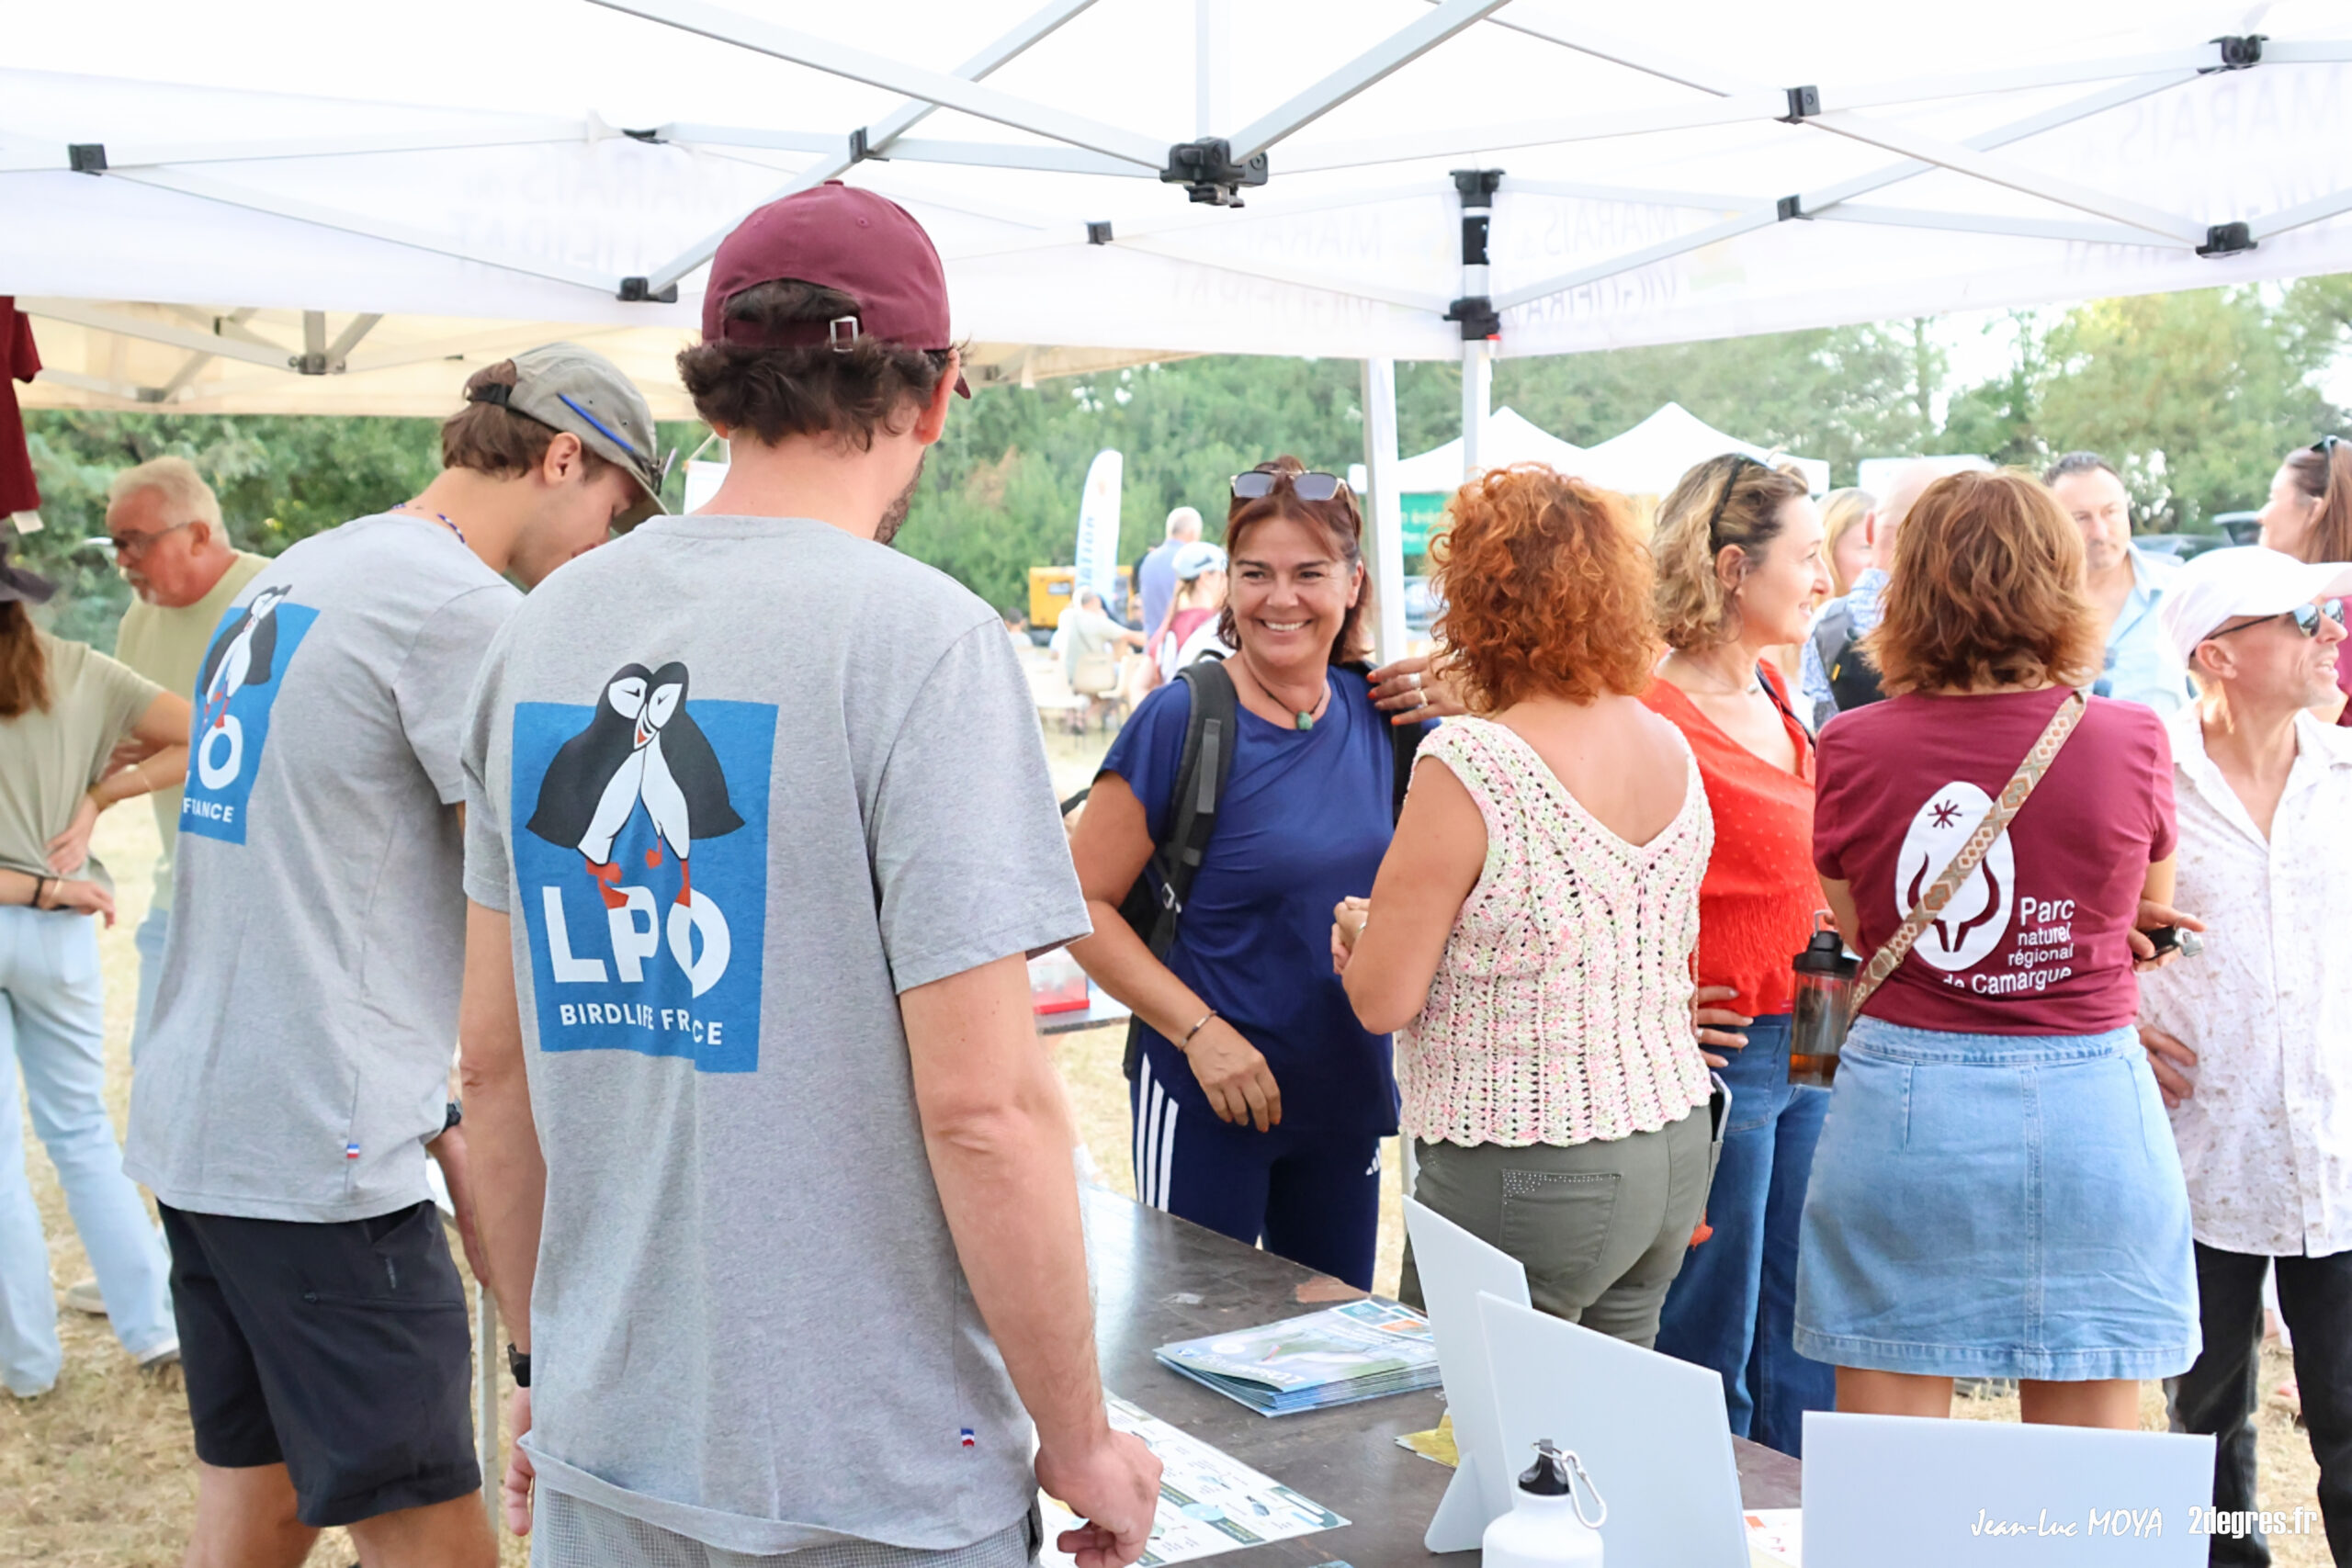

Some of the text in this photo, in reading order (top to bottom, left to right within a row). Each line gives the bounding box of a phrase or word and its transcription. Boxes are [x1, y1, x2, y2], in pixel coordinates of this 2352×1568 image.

[2020, 897, 2075, 926] Parc
[542, 885, 731, 998] LPO
[2018, 922, 2072, 946] naturel
[2007, 943, 2075, 969] régional
[1972, 966, 2072, 995] Camargue
[560, 1003, 654, 1031] BIRDLIFE
